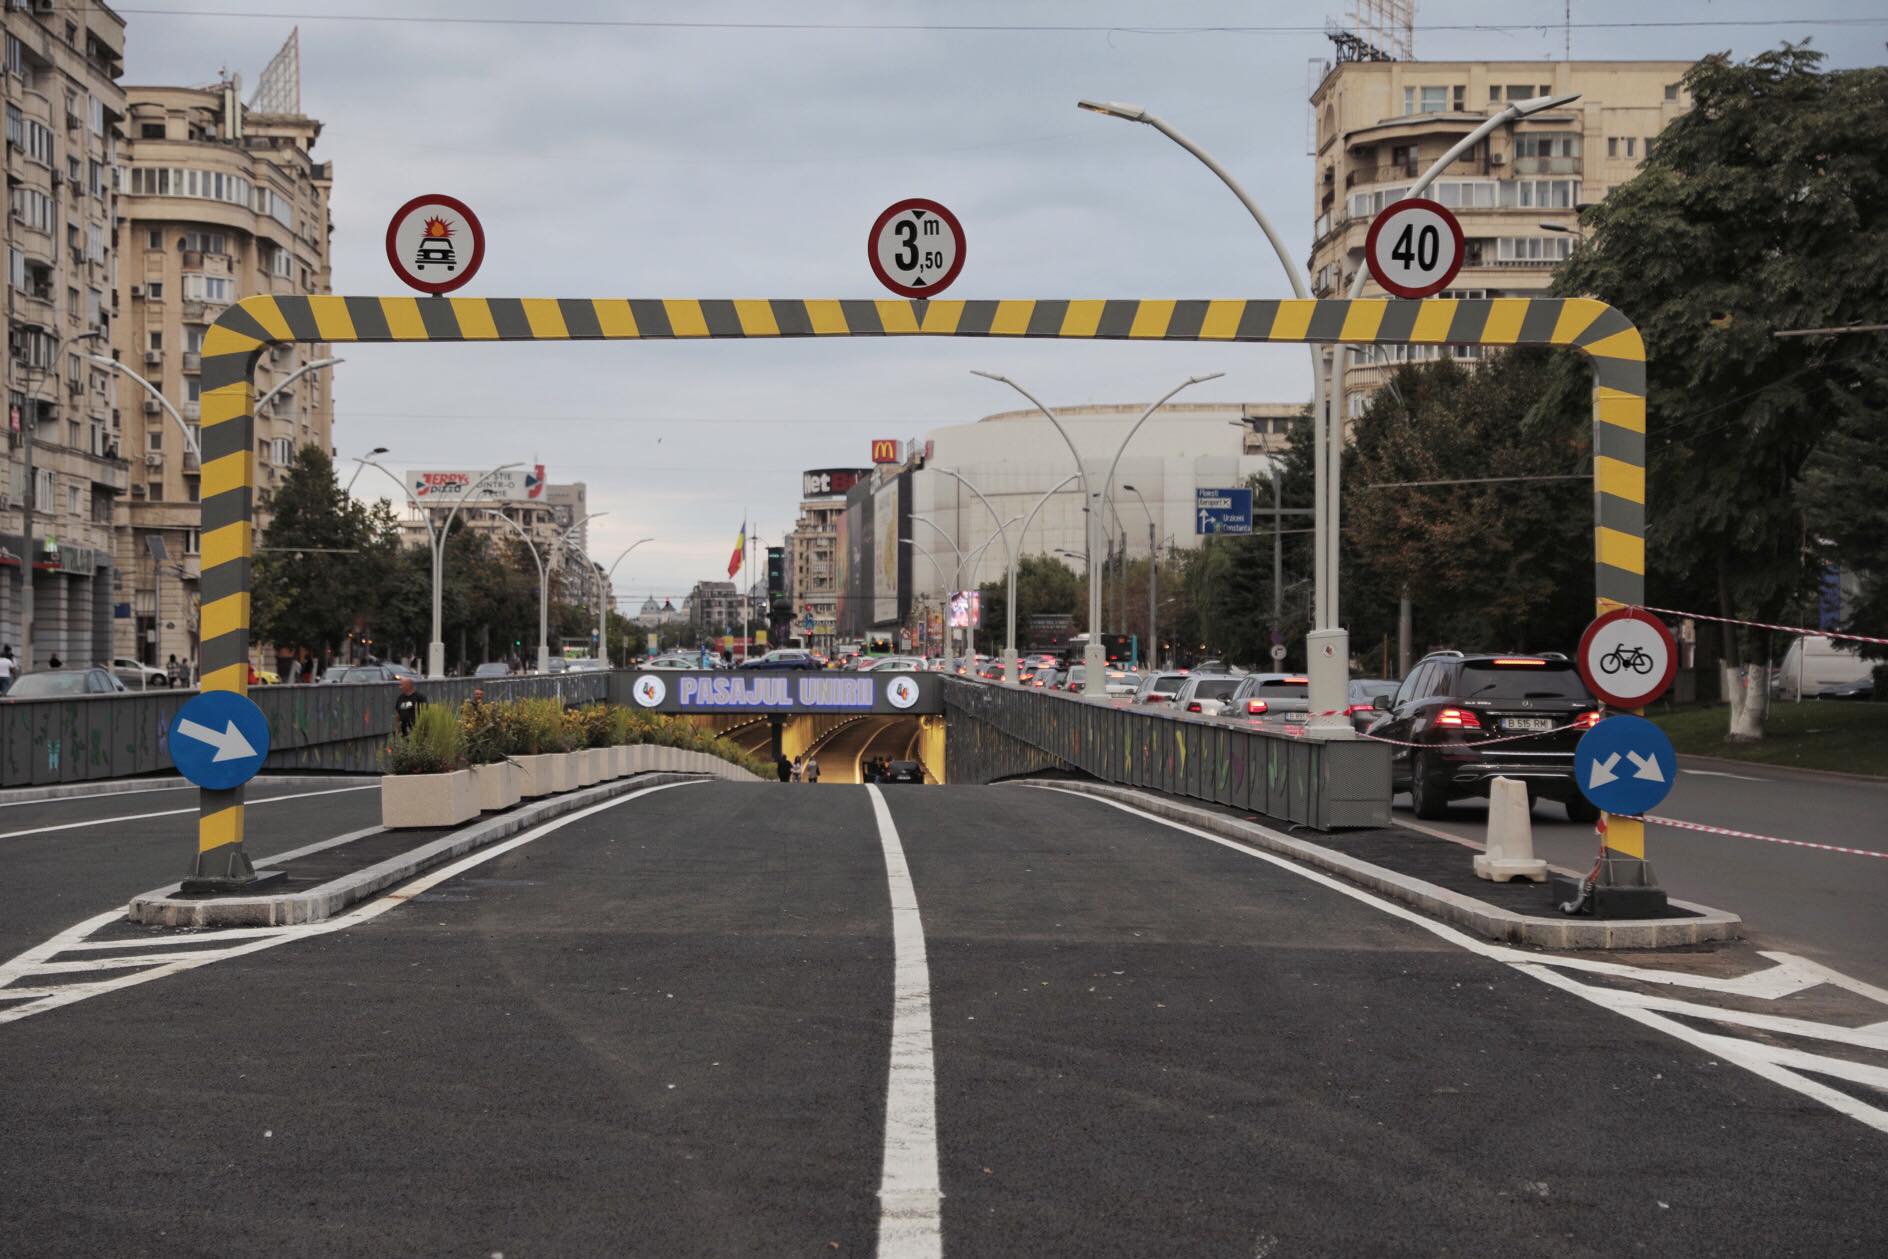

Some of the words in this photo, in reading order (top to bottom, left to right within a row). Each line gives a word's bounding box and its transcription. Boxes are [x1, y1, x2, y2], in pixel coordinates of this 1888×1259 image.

[1391, 224, 1438, 271] 40
[679, 677, 792, 706] PASAJUL
[798, 678, 874, 707] UNIRII
[1509, 719, 1514, 727] B
[1518, 719, 1531, 728] 515
